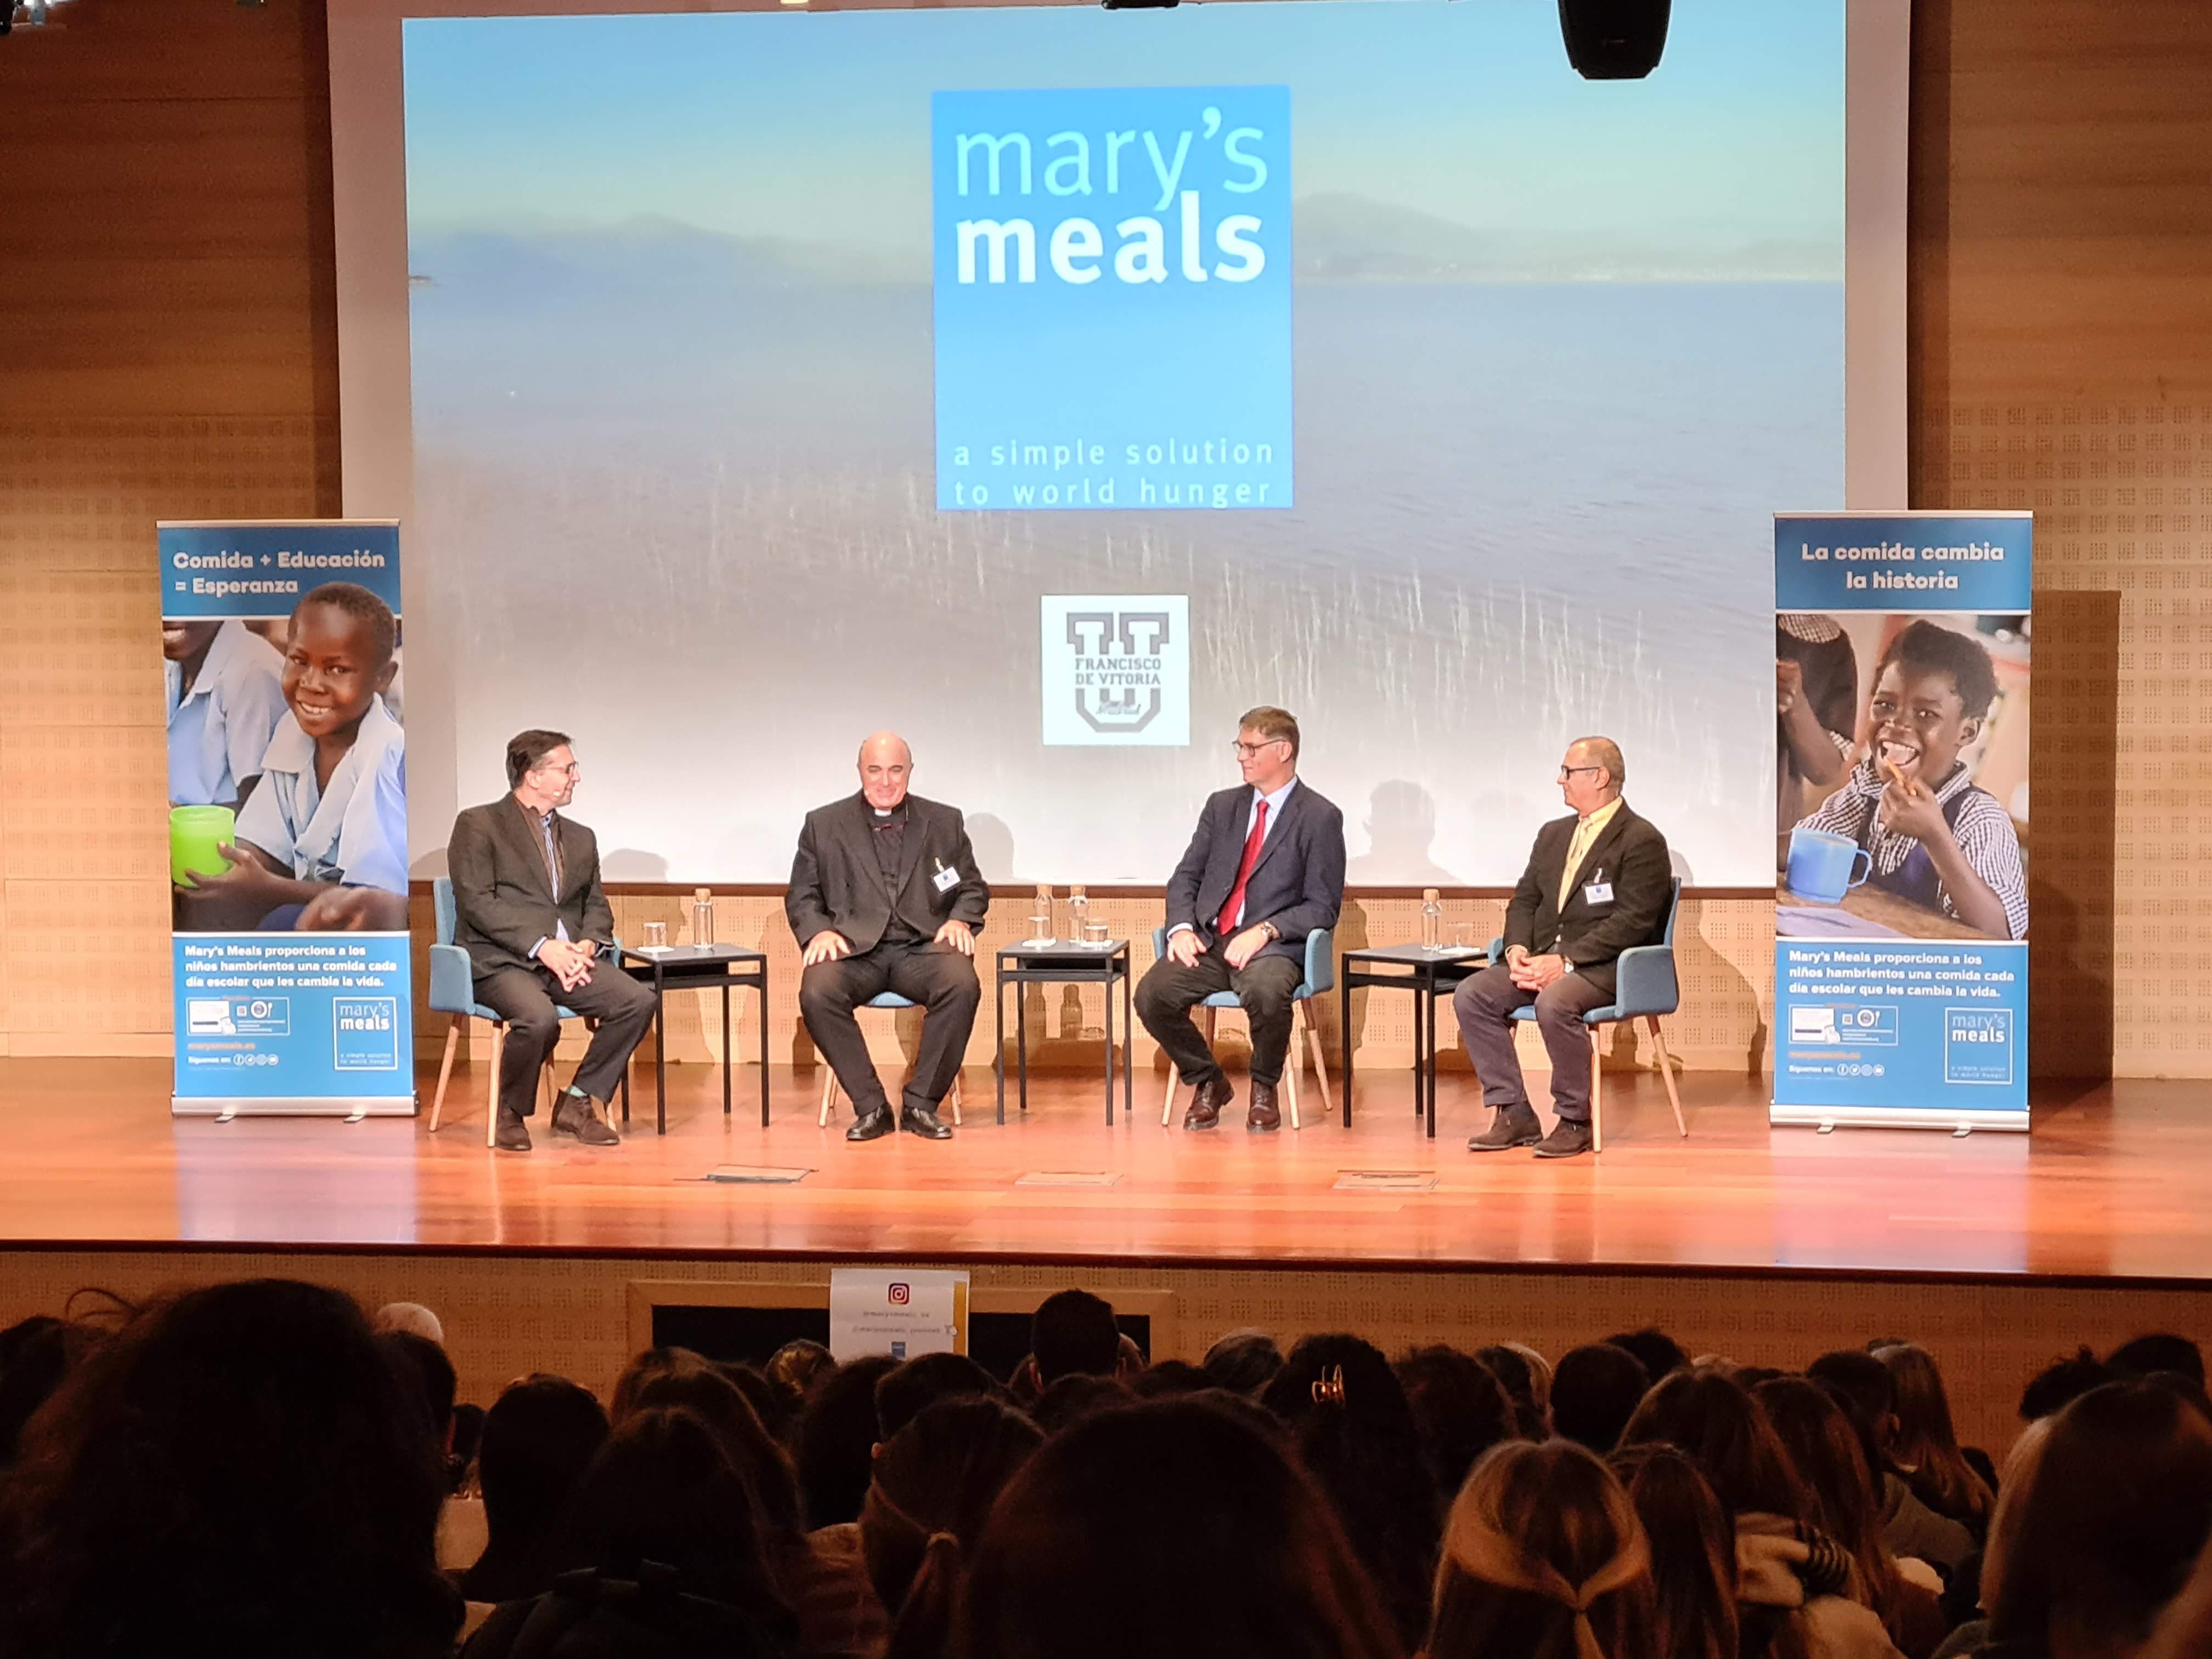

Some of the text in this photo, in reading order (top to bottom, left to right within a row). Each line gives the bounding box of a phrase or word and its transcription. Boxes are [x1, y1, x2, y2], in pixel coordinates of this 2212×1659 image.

[955, 106, 1268, 211] mary's
[956, 190, 1266, 285] meals
[955, 438, 1272, 471] a simple solution
[955, 478, 1270, 509] to world hunger
[173, 551, 253, 569] Comida
[278, 549, 385, 568] Educación
[1802, 541, 2005, 561] La comida cambia
[1846, 569, 1960, 589] la historia
[193, 578, 298, 597] Esperanza
[1075, 657, 1161, 670] FRANCISCO
[1075, 672, 1161, 685] DE VITORIA
[184, 945, 224, 959] Mary's
[227, 945, 262, 956] Meals
[265, 946, 335, 959] proporciona
[348, 945, 365, 956] los
[1789, 950, 1982, 967] Mary's Meals proporciona a los
[185, 960, 397, 972] niños hambrientos una comida cada
[207, 976, 249, 987] escolar
[252, 978, 274, 989] que
[278, 976, 294, 987] les
[297, 976, 340, 987] cambia
[342, 976, 353, 987] la
[356, 975, 384, 987] vida.
[1789, 967, 2015, 982] niños hambrientos una comida cada
[1811, 983, 1856, 995] escolar
[1859, 985, 1883, 997] que
[1886, 984, 1904, 996] les
[1907, 984, 1953, 996] cambia
[1956, 985, 1967, 997] la
[1970, 985, 2001, 997] vida.
[340, 1002, 390, 1018] mary's
[340, 1014, 390, 1030] meals
[1952, 1013, 2005, 1030] mary's
[1952, 1027, 2005, 1043] meals
